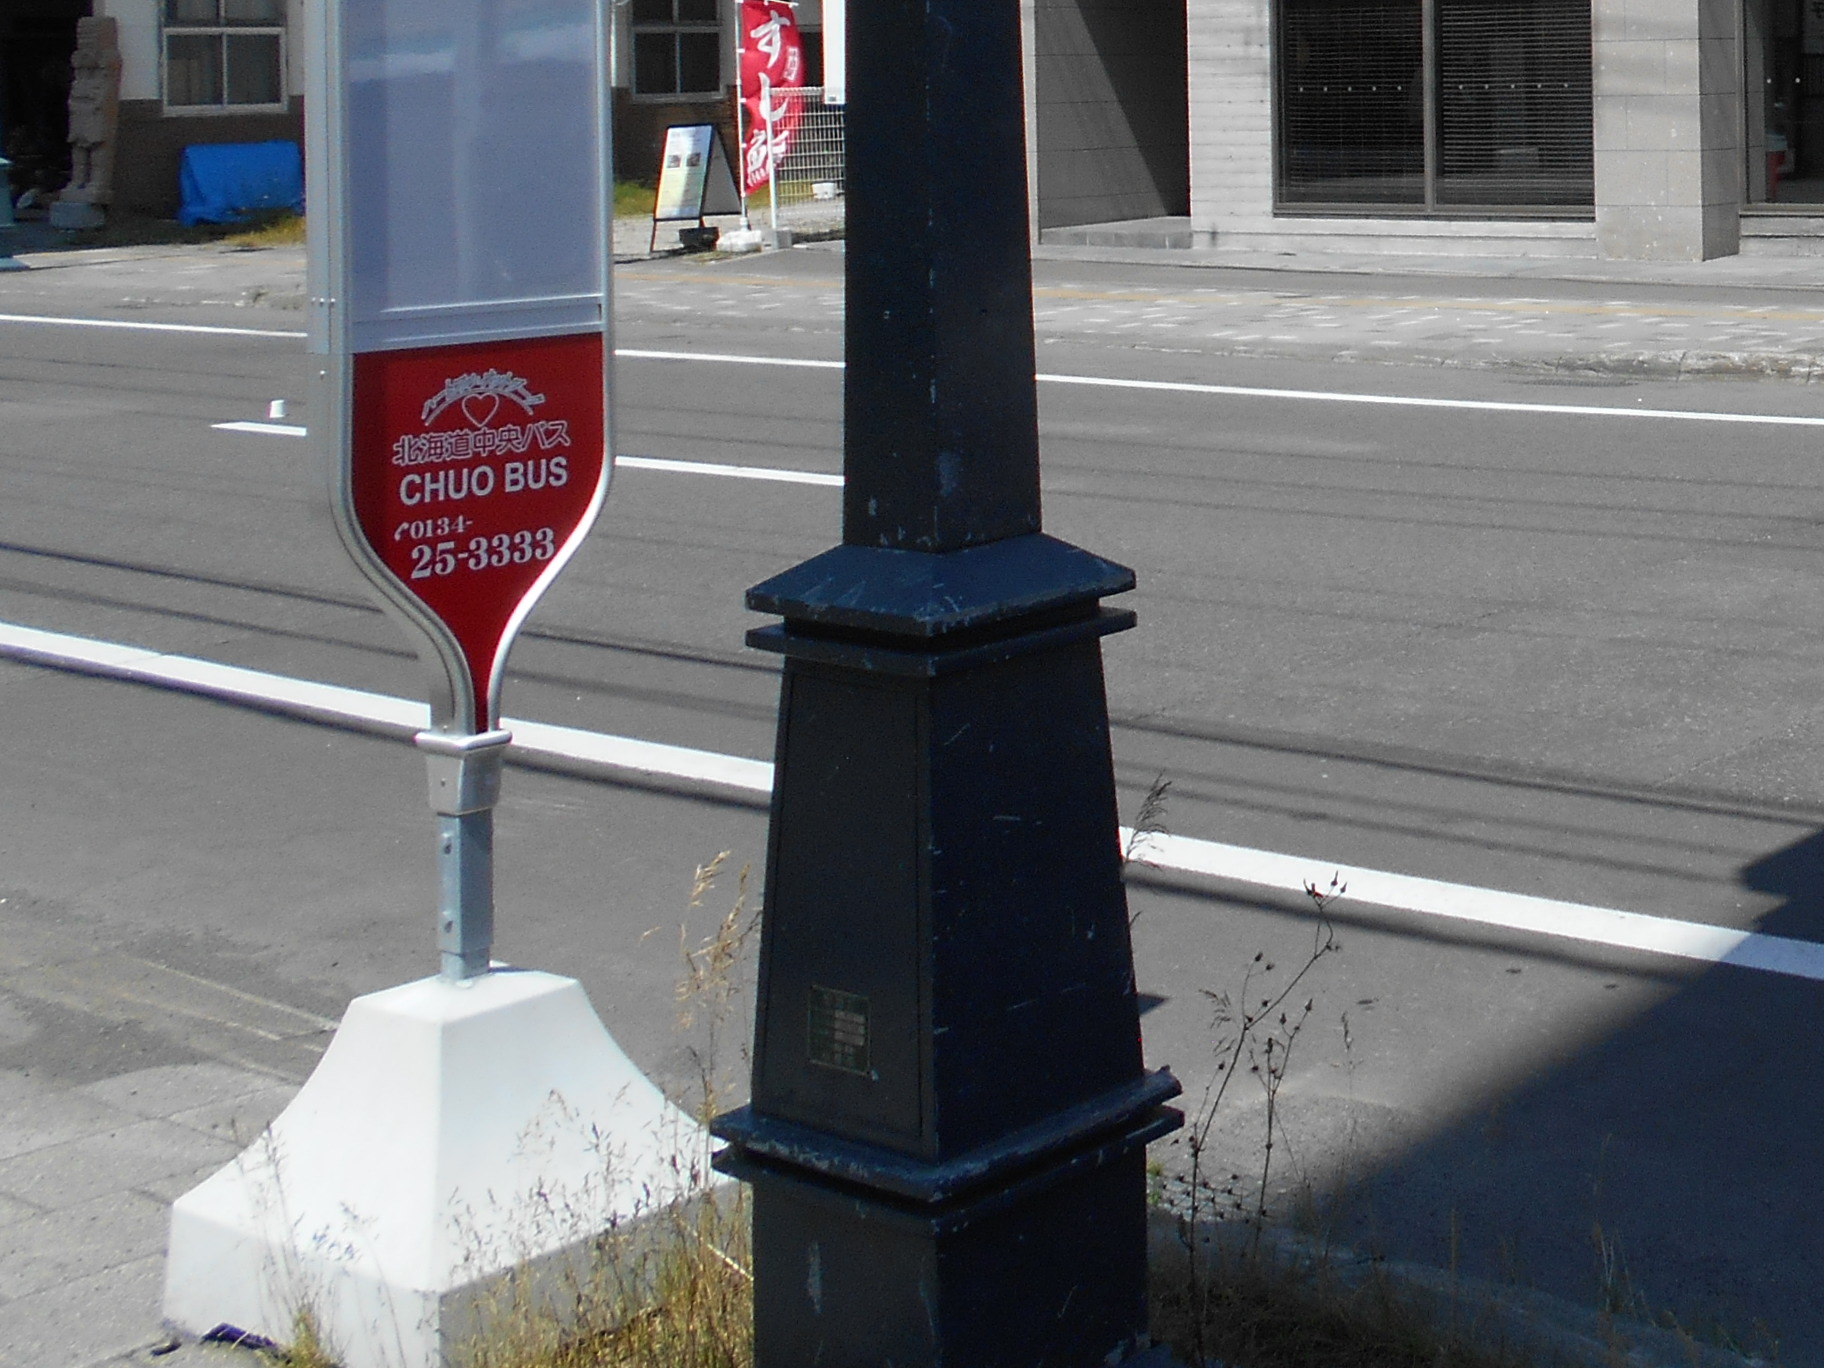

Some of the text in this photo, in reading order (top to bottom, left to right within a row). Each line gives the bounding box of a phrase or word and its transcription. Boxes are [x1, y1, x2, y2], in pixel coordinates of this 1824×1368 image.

[392, 420, 571, 467] 北海道中央バス
[400, 456, 568, 506] CHUO BUS
[410, 527, 556, 579] 25-3333
